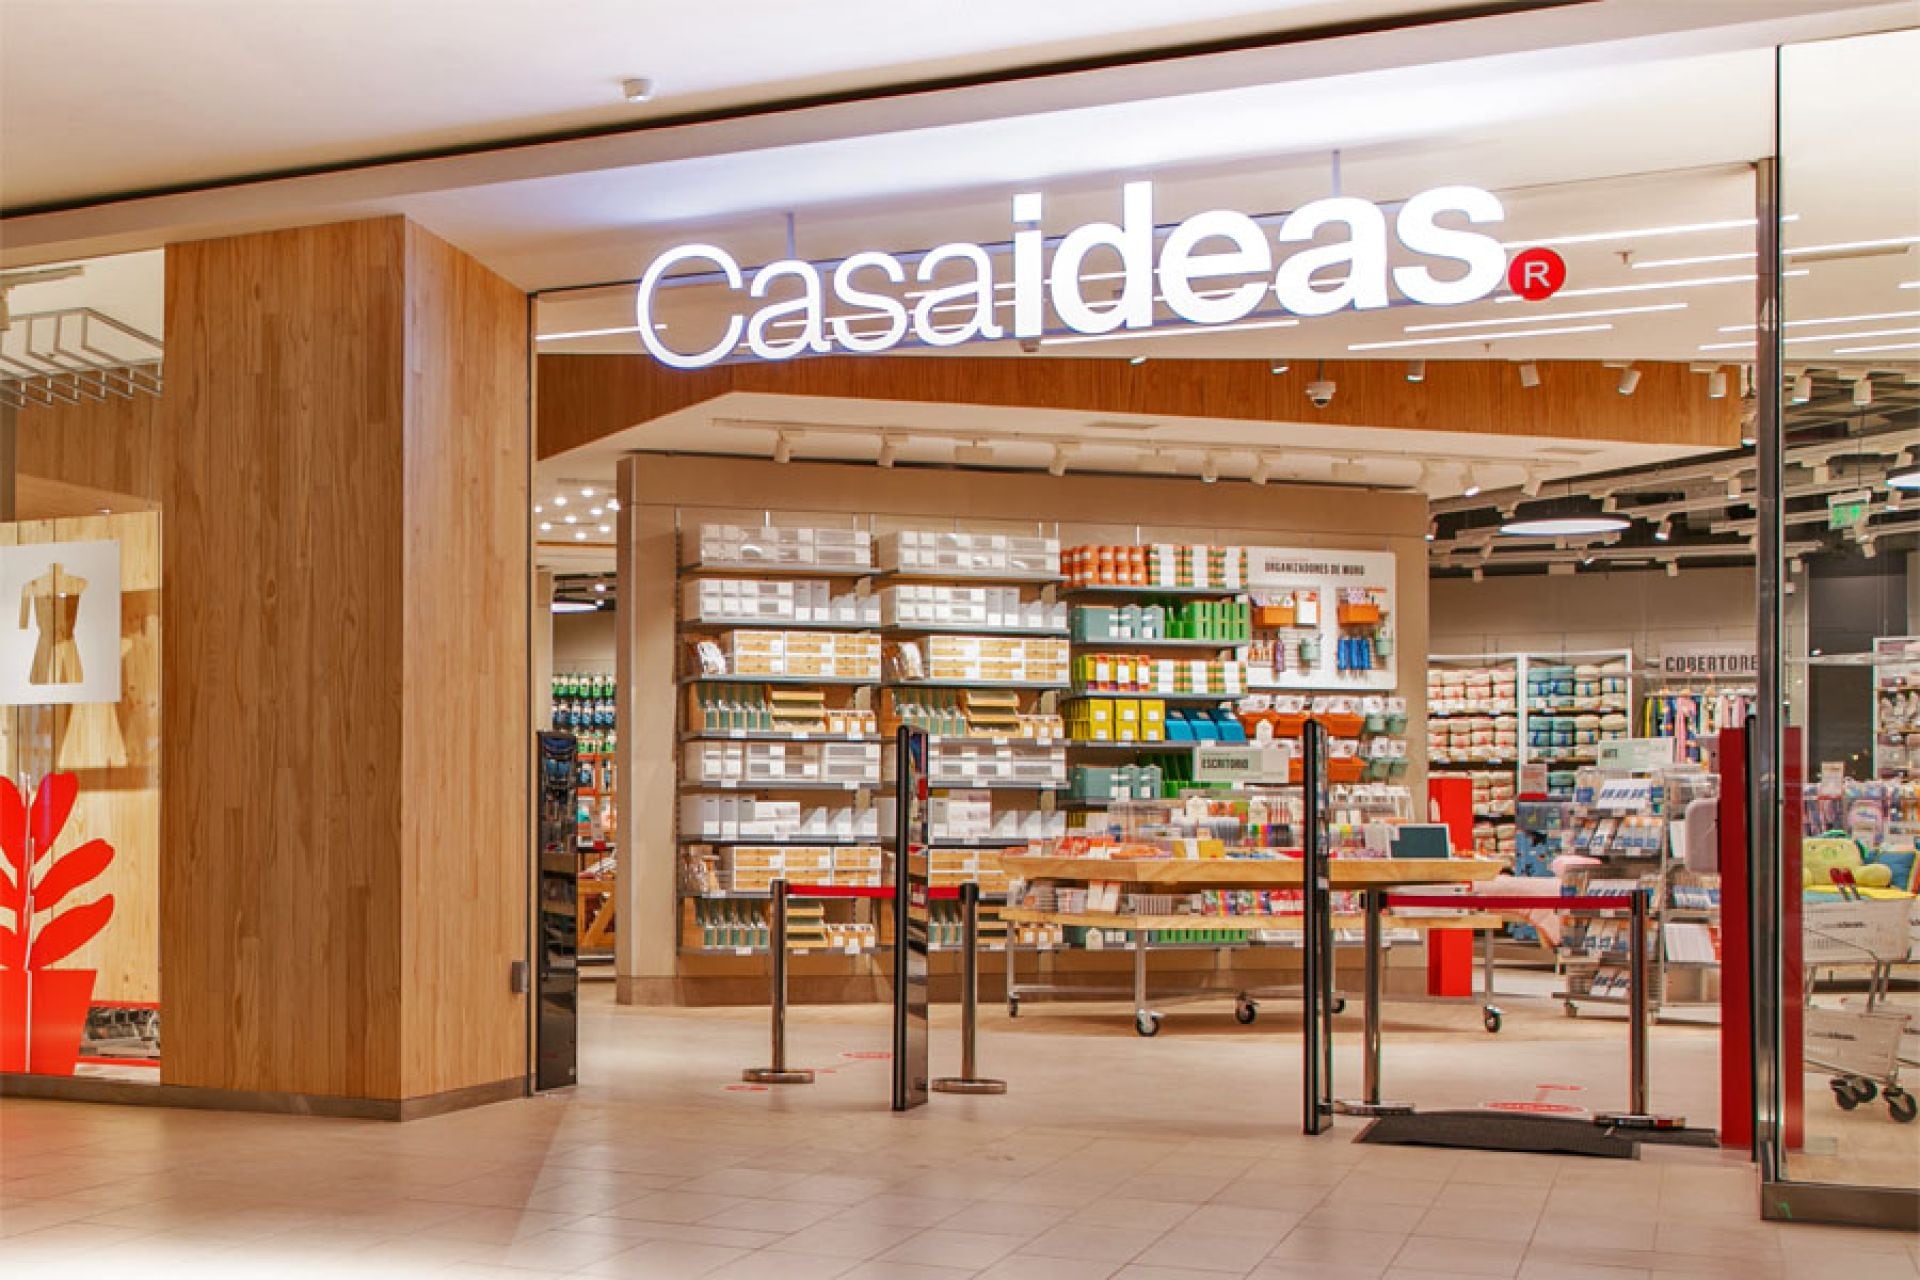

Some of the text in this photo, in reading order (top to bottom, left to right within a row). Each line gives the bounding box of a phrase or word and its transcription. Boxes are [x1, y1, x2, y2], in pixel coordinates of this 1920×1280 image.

[637, 181, 1507, 370] Casaideas
[1264, 562, 1328, 575] ORGANIZADORES
[1330, 563, 1340, 575] DE
[1201, 758, 1249, 769] ESCRITORIO
